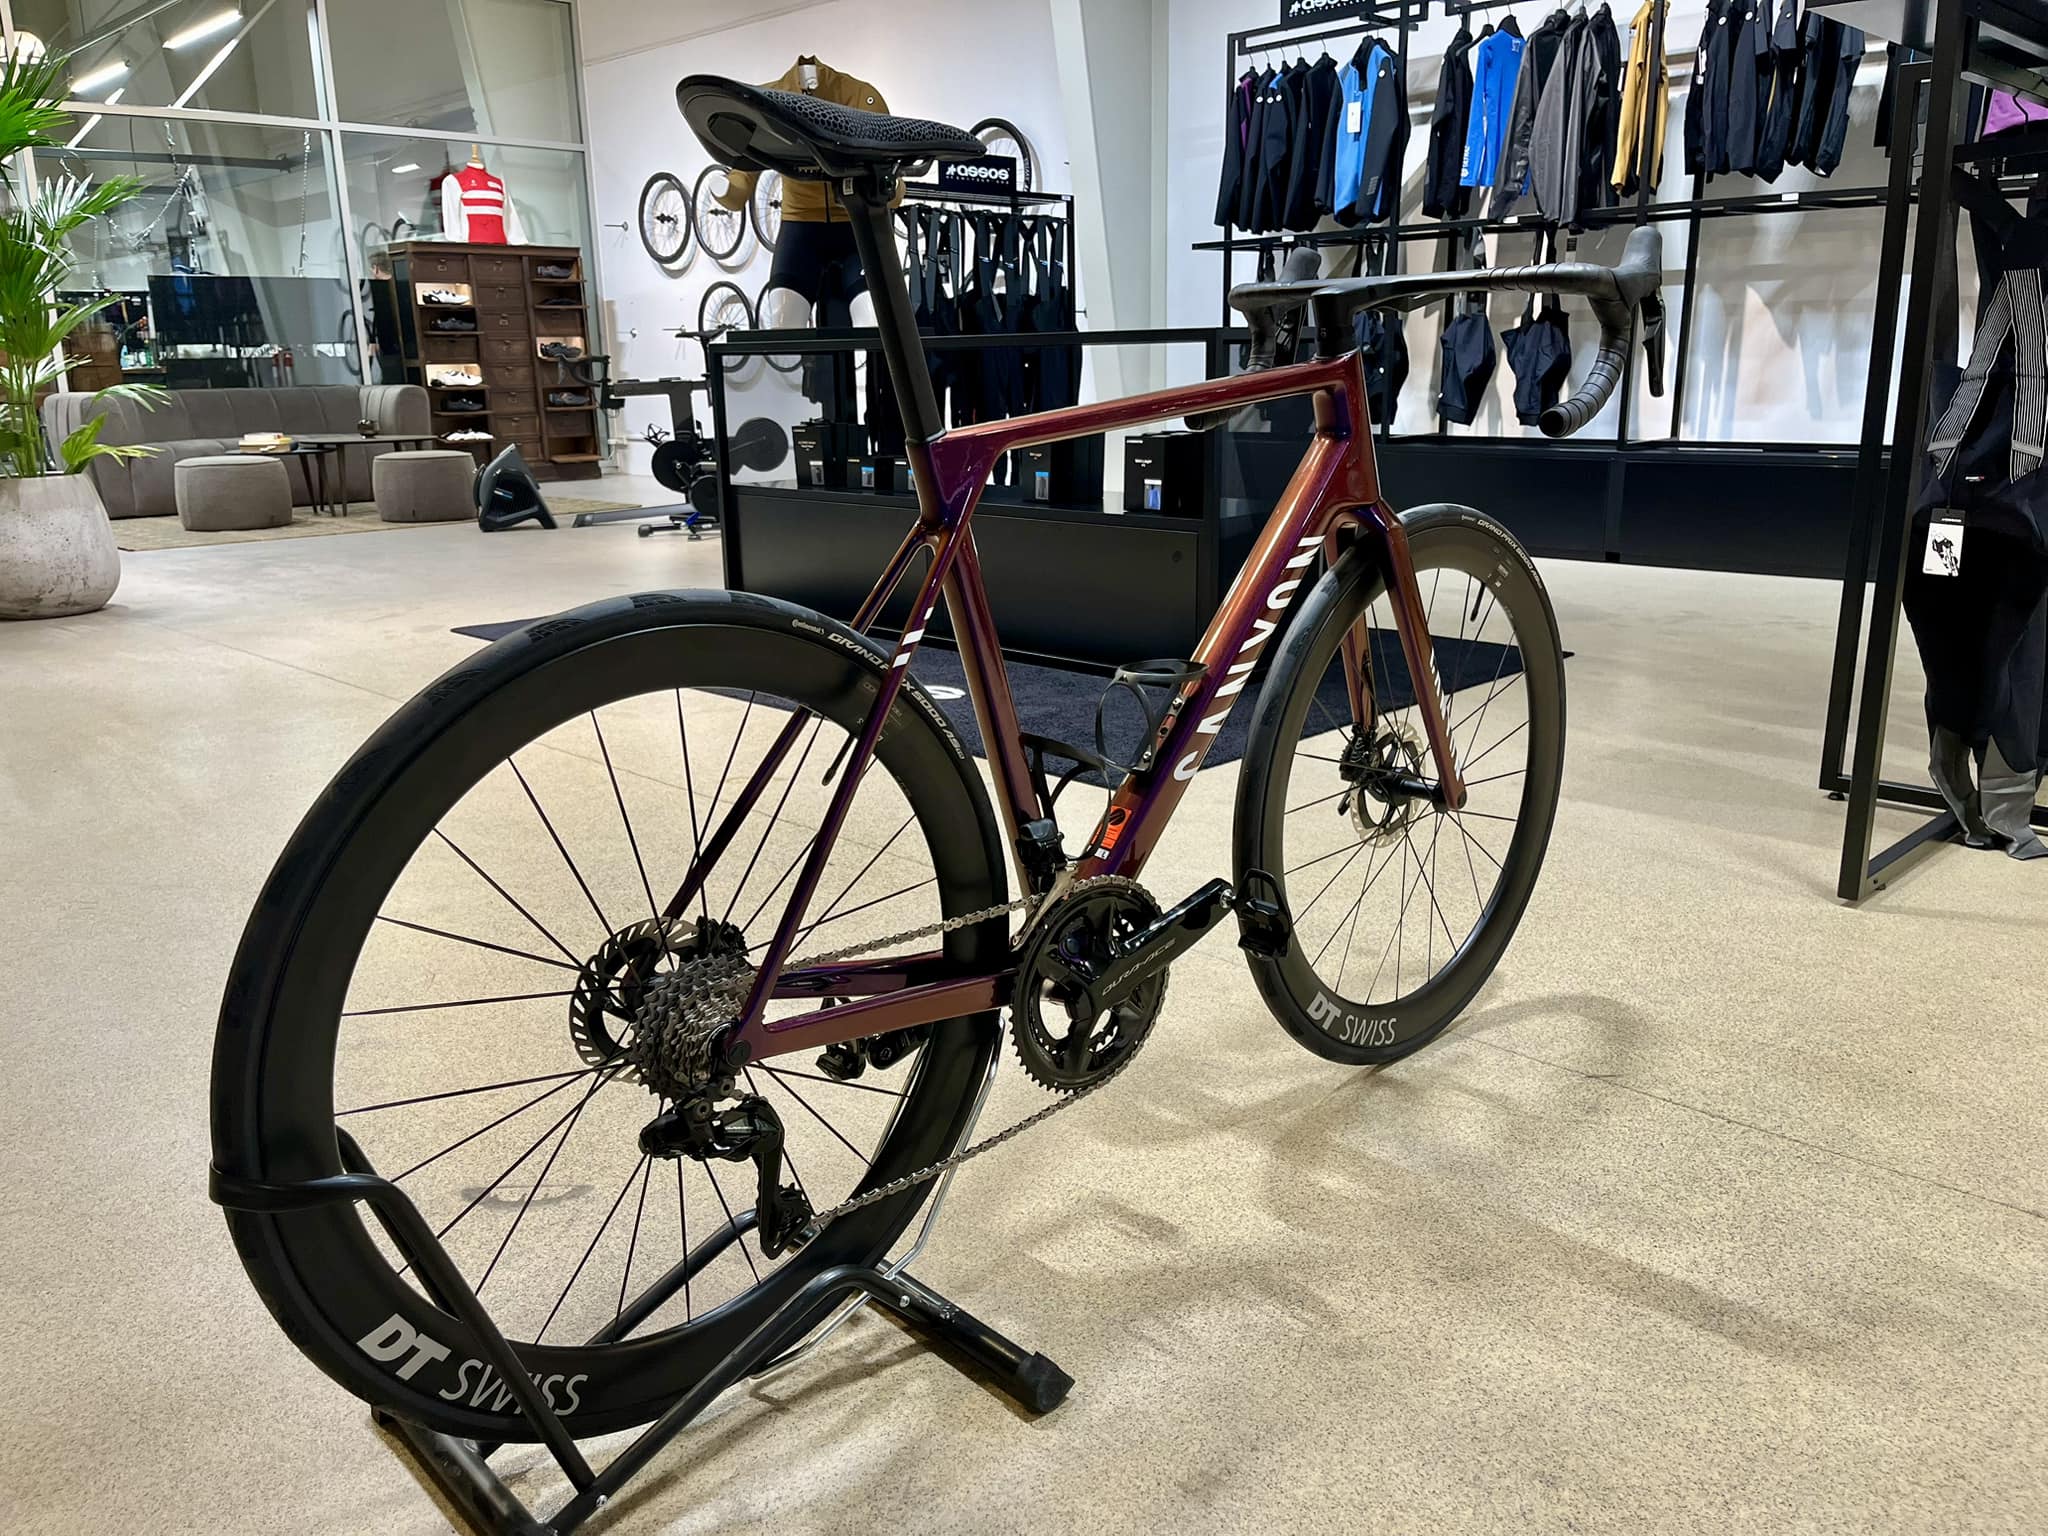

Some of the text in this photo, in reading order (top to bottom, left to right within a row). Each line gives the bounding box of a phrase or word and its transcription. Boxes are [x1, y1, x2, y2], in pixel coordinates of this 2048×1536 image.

[956, 164, 1010, 180] assos
[827, 632, 884, 666] GRAND
[912, 690, 947, 728] 5000
[1306, 990, 1397, 1046] DT SWISS
[356, 1312, 452, 1381] DT
